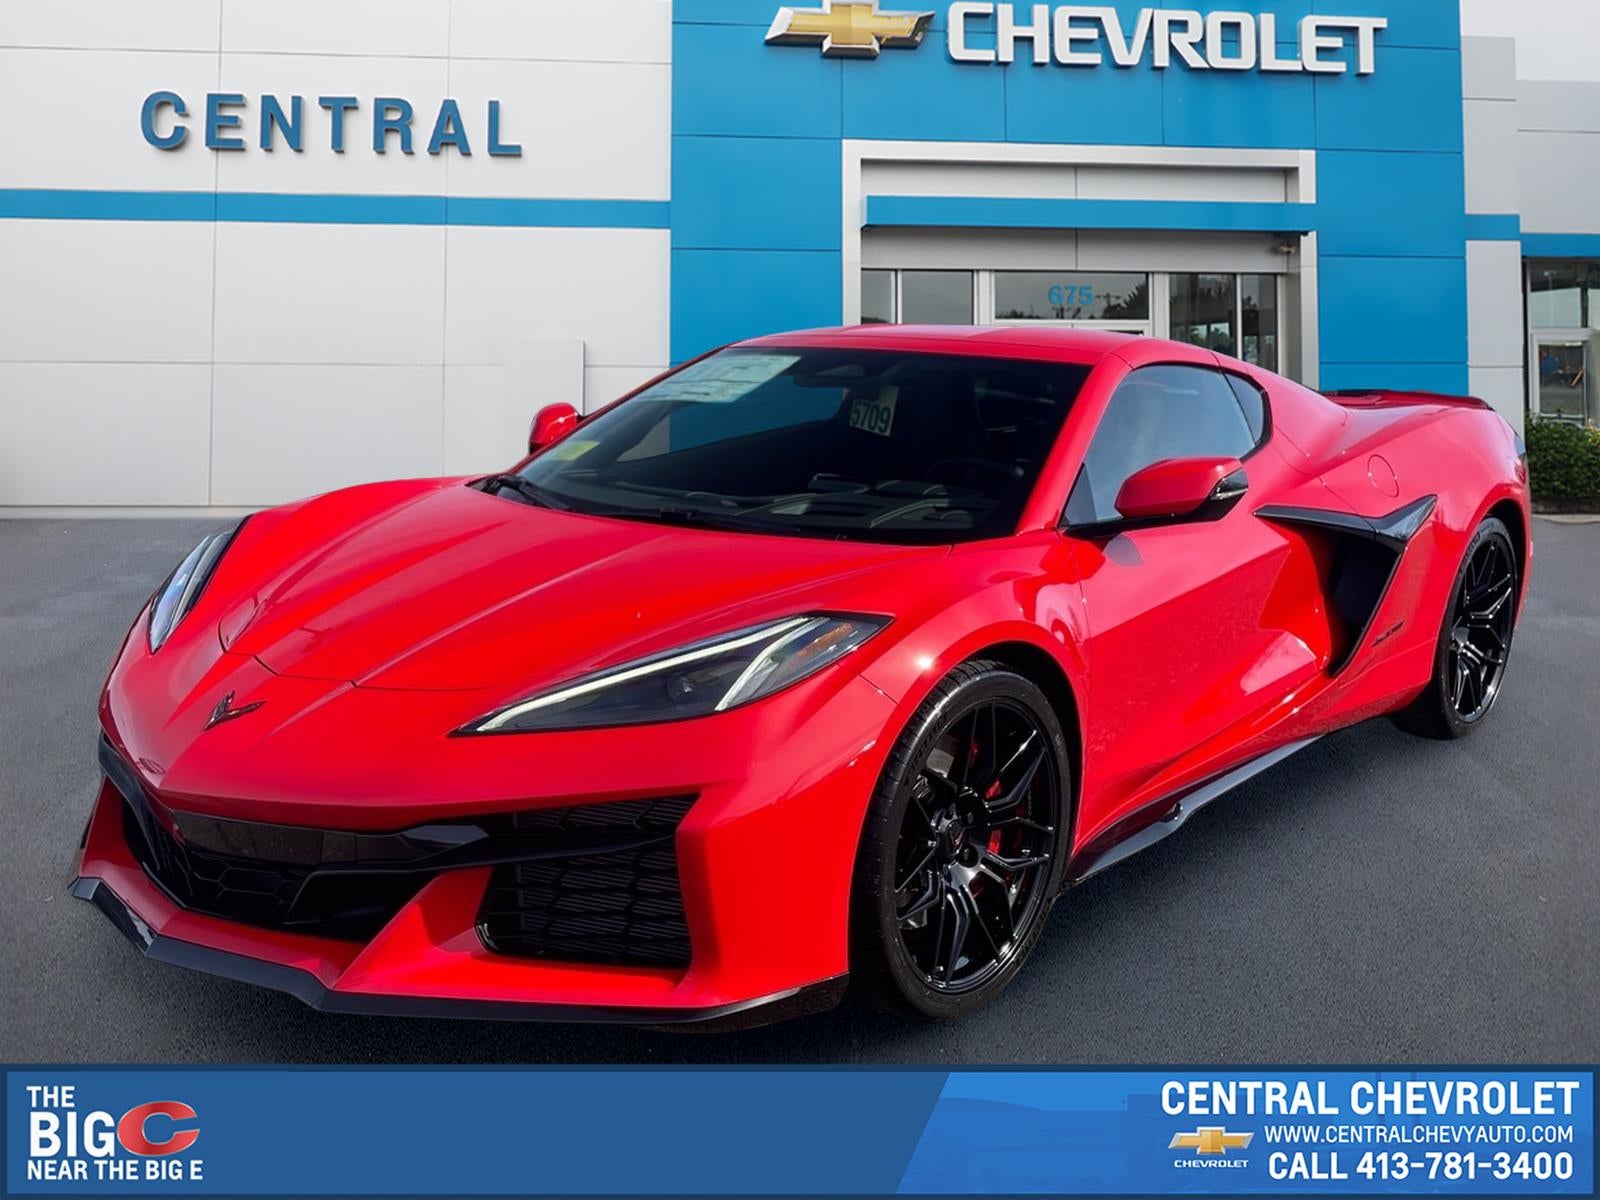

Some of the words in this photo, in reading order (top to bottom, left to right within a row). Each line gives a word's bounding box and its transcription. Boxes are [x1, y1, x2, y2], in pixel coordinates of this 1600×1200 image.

[947, 1, 1388, 75] CHEVROLET
[140, 90, 522, 157] CENTRAL
[1047, 283, 1094, 305] 675
[851, 400, 891, 433] 5709
